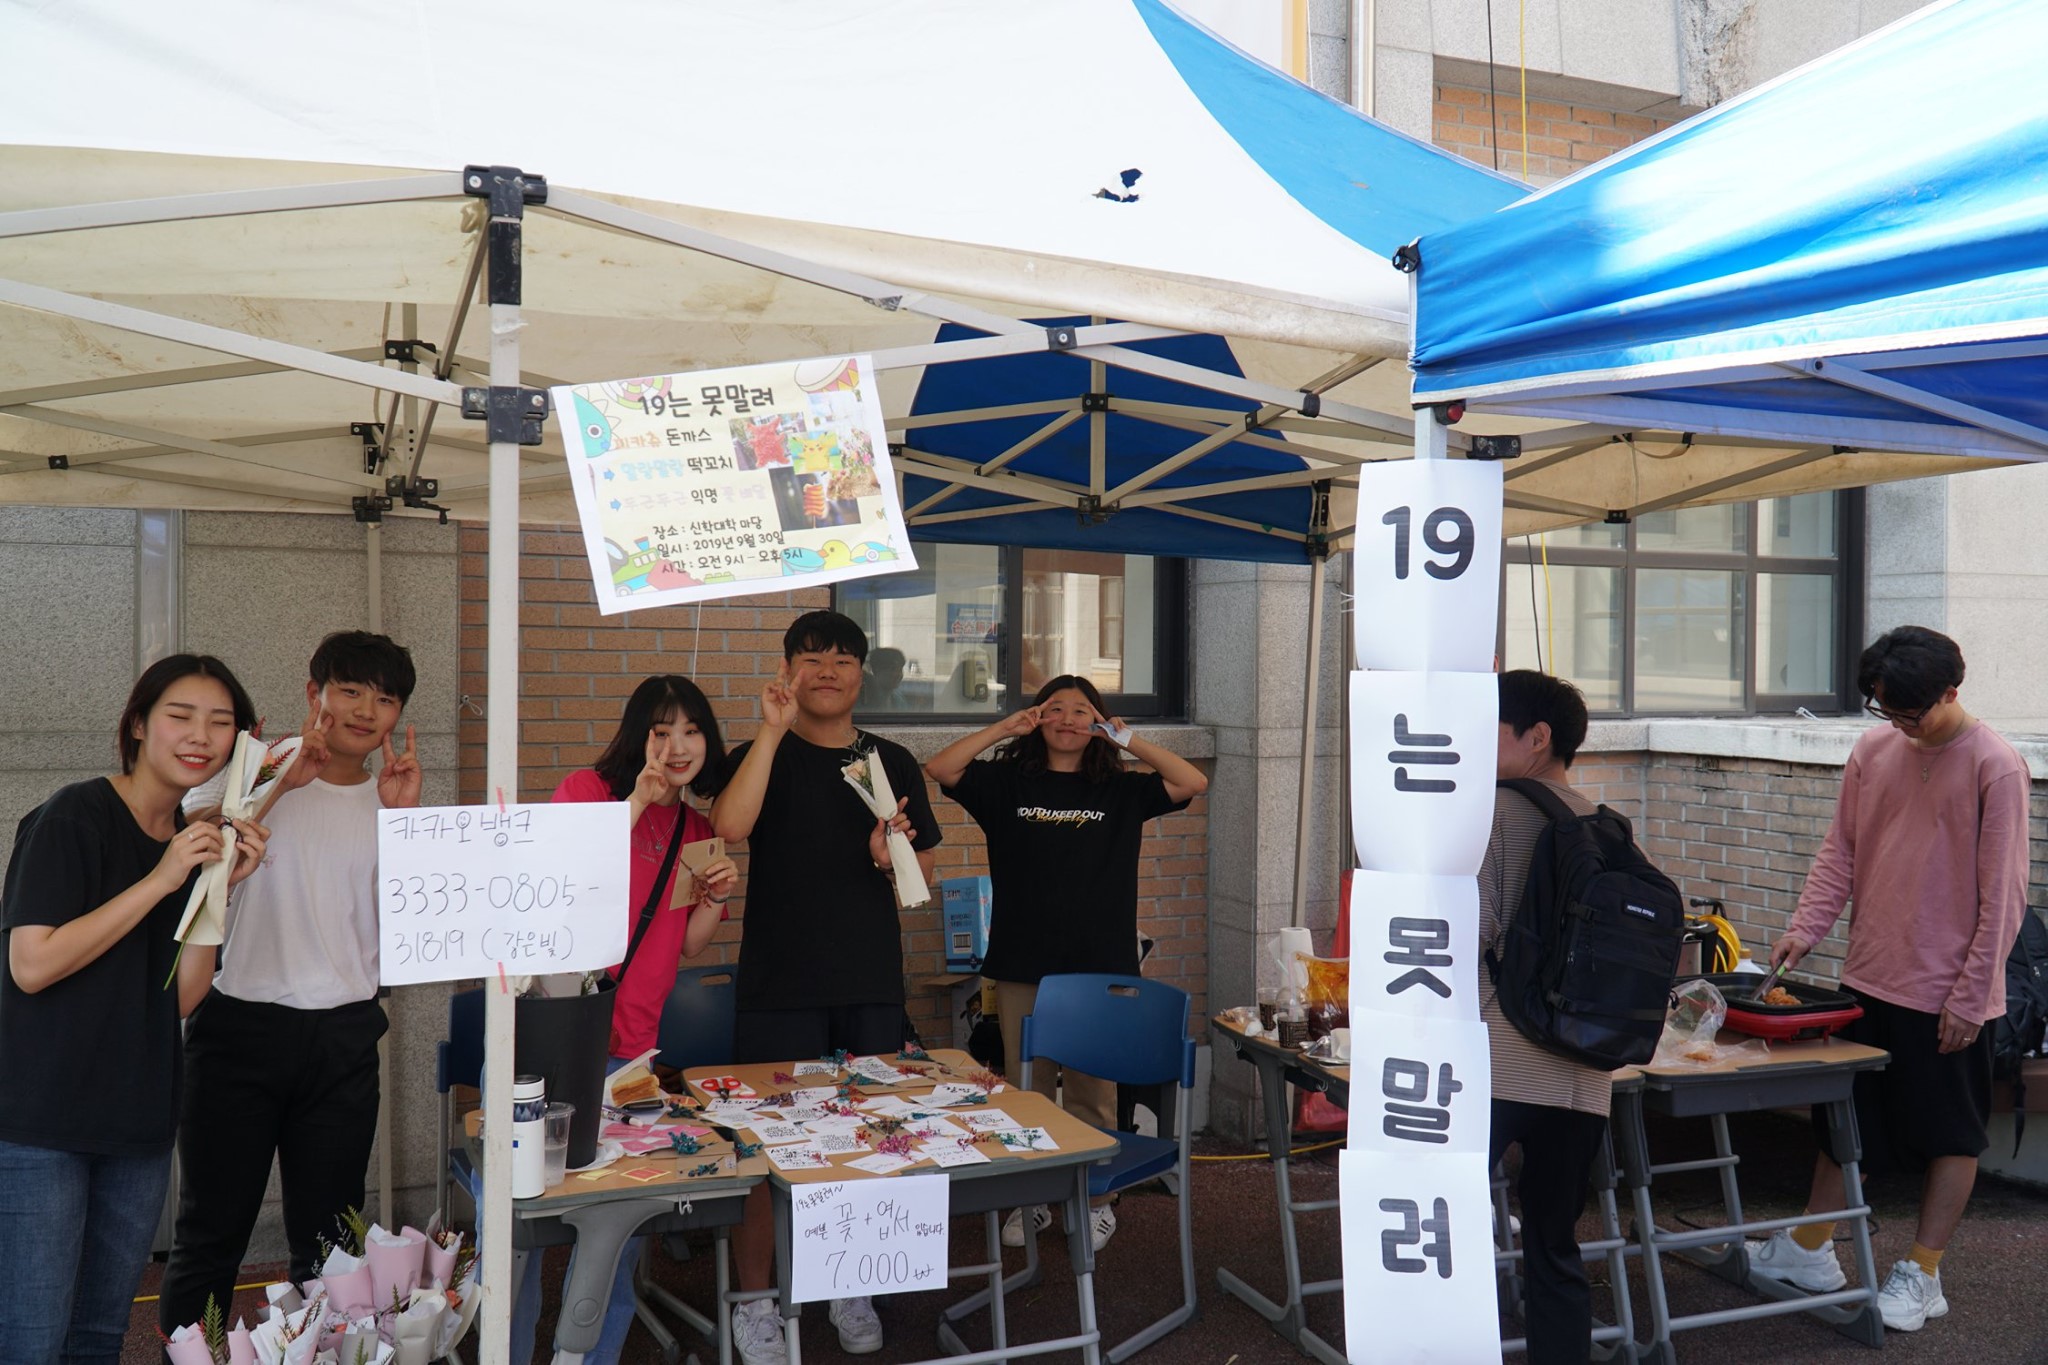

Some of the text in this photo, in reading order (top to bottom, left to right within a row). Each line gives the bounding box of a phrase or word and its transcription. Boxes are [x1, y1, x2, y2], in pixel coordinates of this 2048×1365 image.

[638, 384, 775, 418] 19는 못말려
[666, 428, 712, 447] 돈까스
[687, 455, 733, 474] 떡꼬치
[690, 488, 718, 504] 익명
[653, 525, 679, 540] 장소
[690, 518, 736, 535] 신학대학
[740, 516, 762, 530] 마당
[657, 544, 682, 557] 일시
[693, 536, 733, 550] 2019년
[737, 534, 755, 547] 9월
[758, 531, 785, 545] 30일
[662, 559, 686, 573] 시간
[698, 556, 722, 569] 오전
[725, 554, 744, 566] 9시
[759, 549, 781, 564] 오후
[784, 548, 802, 560] 5시
[1052, 809, 1081, 819] KEEP
[1081, 810, 1105, 821] OUT
[394, 929, 464, 965] 31819
[804, 1222, 828, 1240] 예쁜
[834, 1202, 857, 1243] 꽃
[877, 1199, 909, 1240] 엽서
